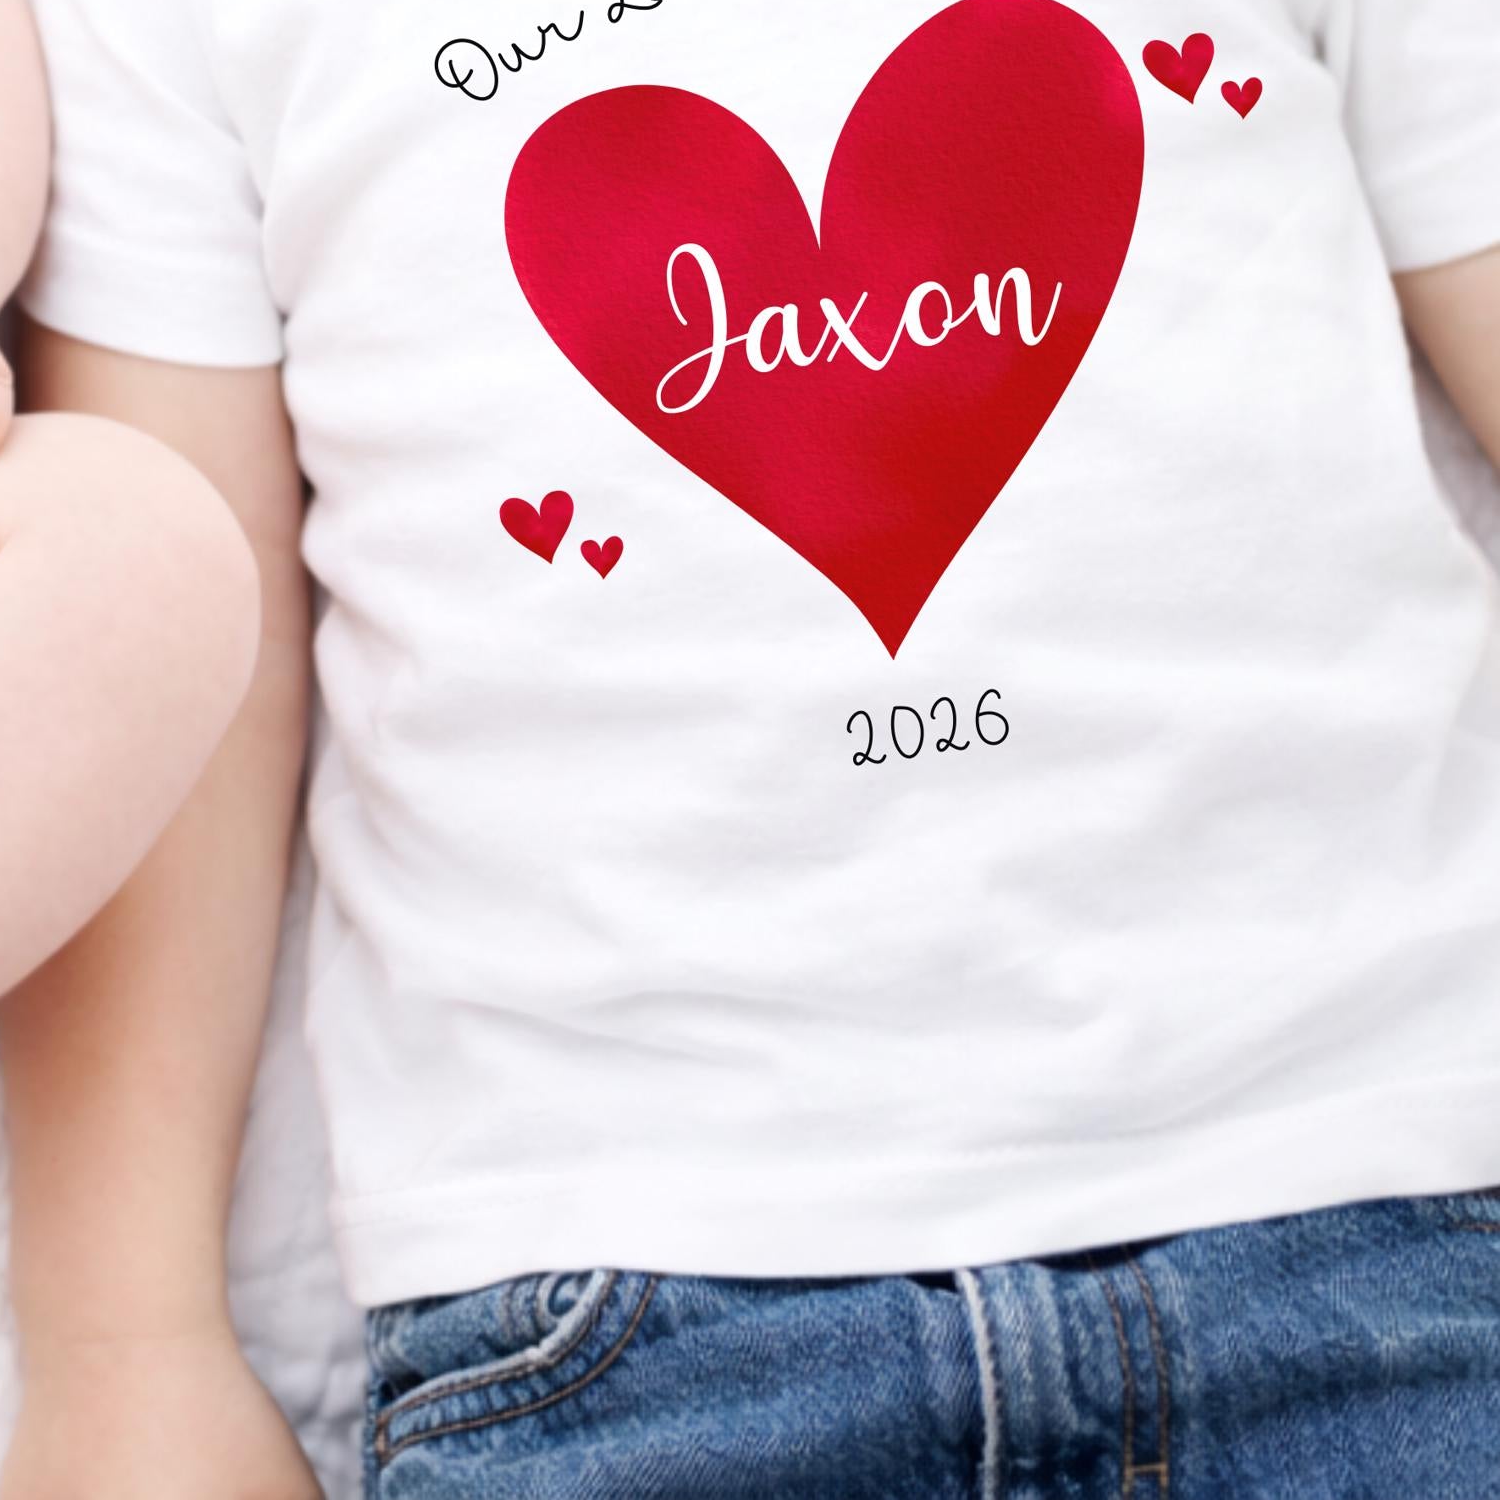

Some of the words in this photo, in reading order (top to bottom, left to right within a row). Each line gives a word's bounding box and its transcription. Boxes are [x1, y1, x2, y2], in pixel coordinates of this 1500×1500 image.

[434, 9, 585, 102] Our
[655, 242, 1063, 414] Jaxon
[846, 688, 1010, 767] 2026
